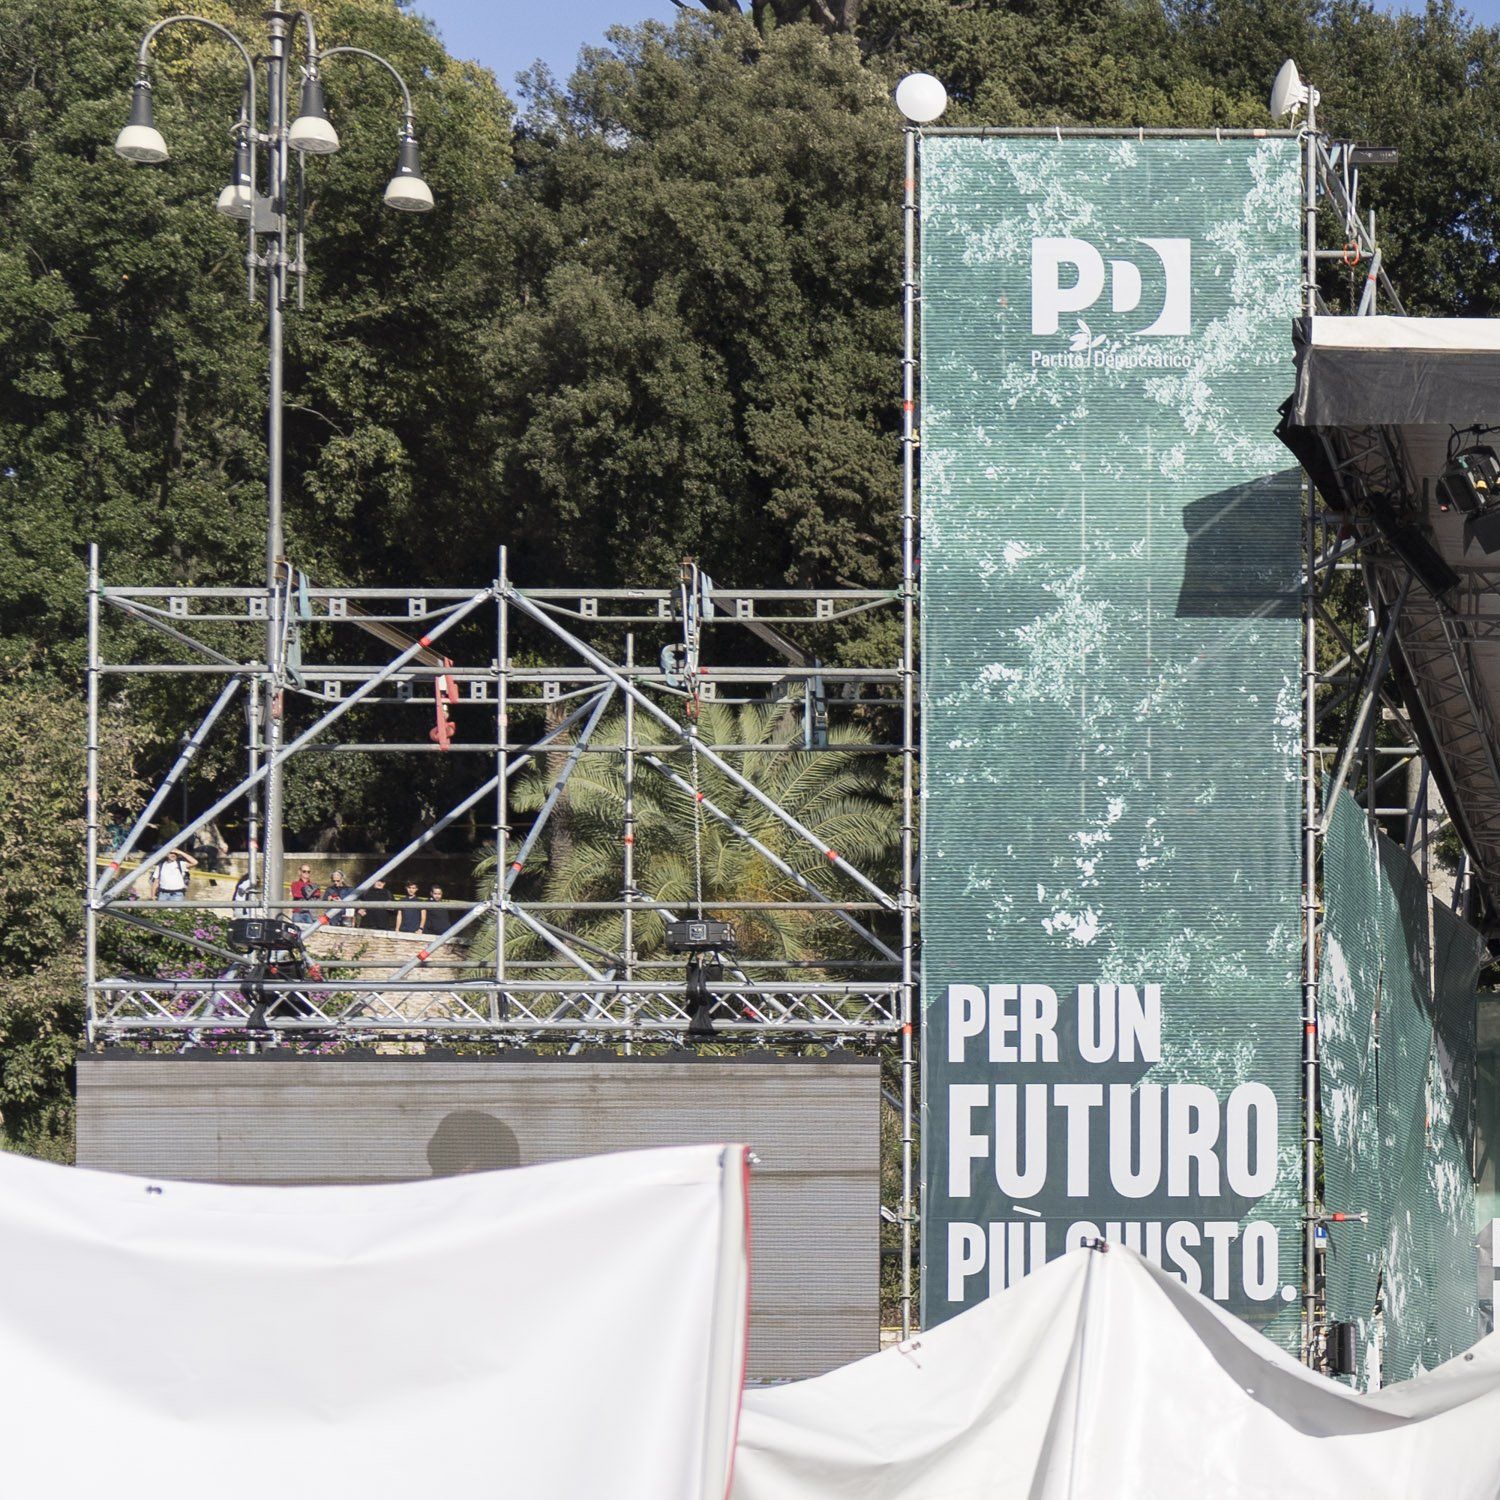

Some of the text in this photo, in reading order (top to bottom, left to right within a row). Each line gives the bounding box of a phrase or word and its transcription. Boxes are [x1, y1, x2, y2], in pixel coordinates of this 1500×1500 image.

[1032, 237, 1191, 336] PD
[1031, 350, 1191, 368] Partito Democratico
[948, 984, 1161, 1064] PER UN
[949, 1082, 1279, 1198] FUTURO
